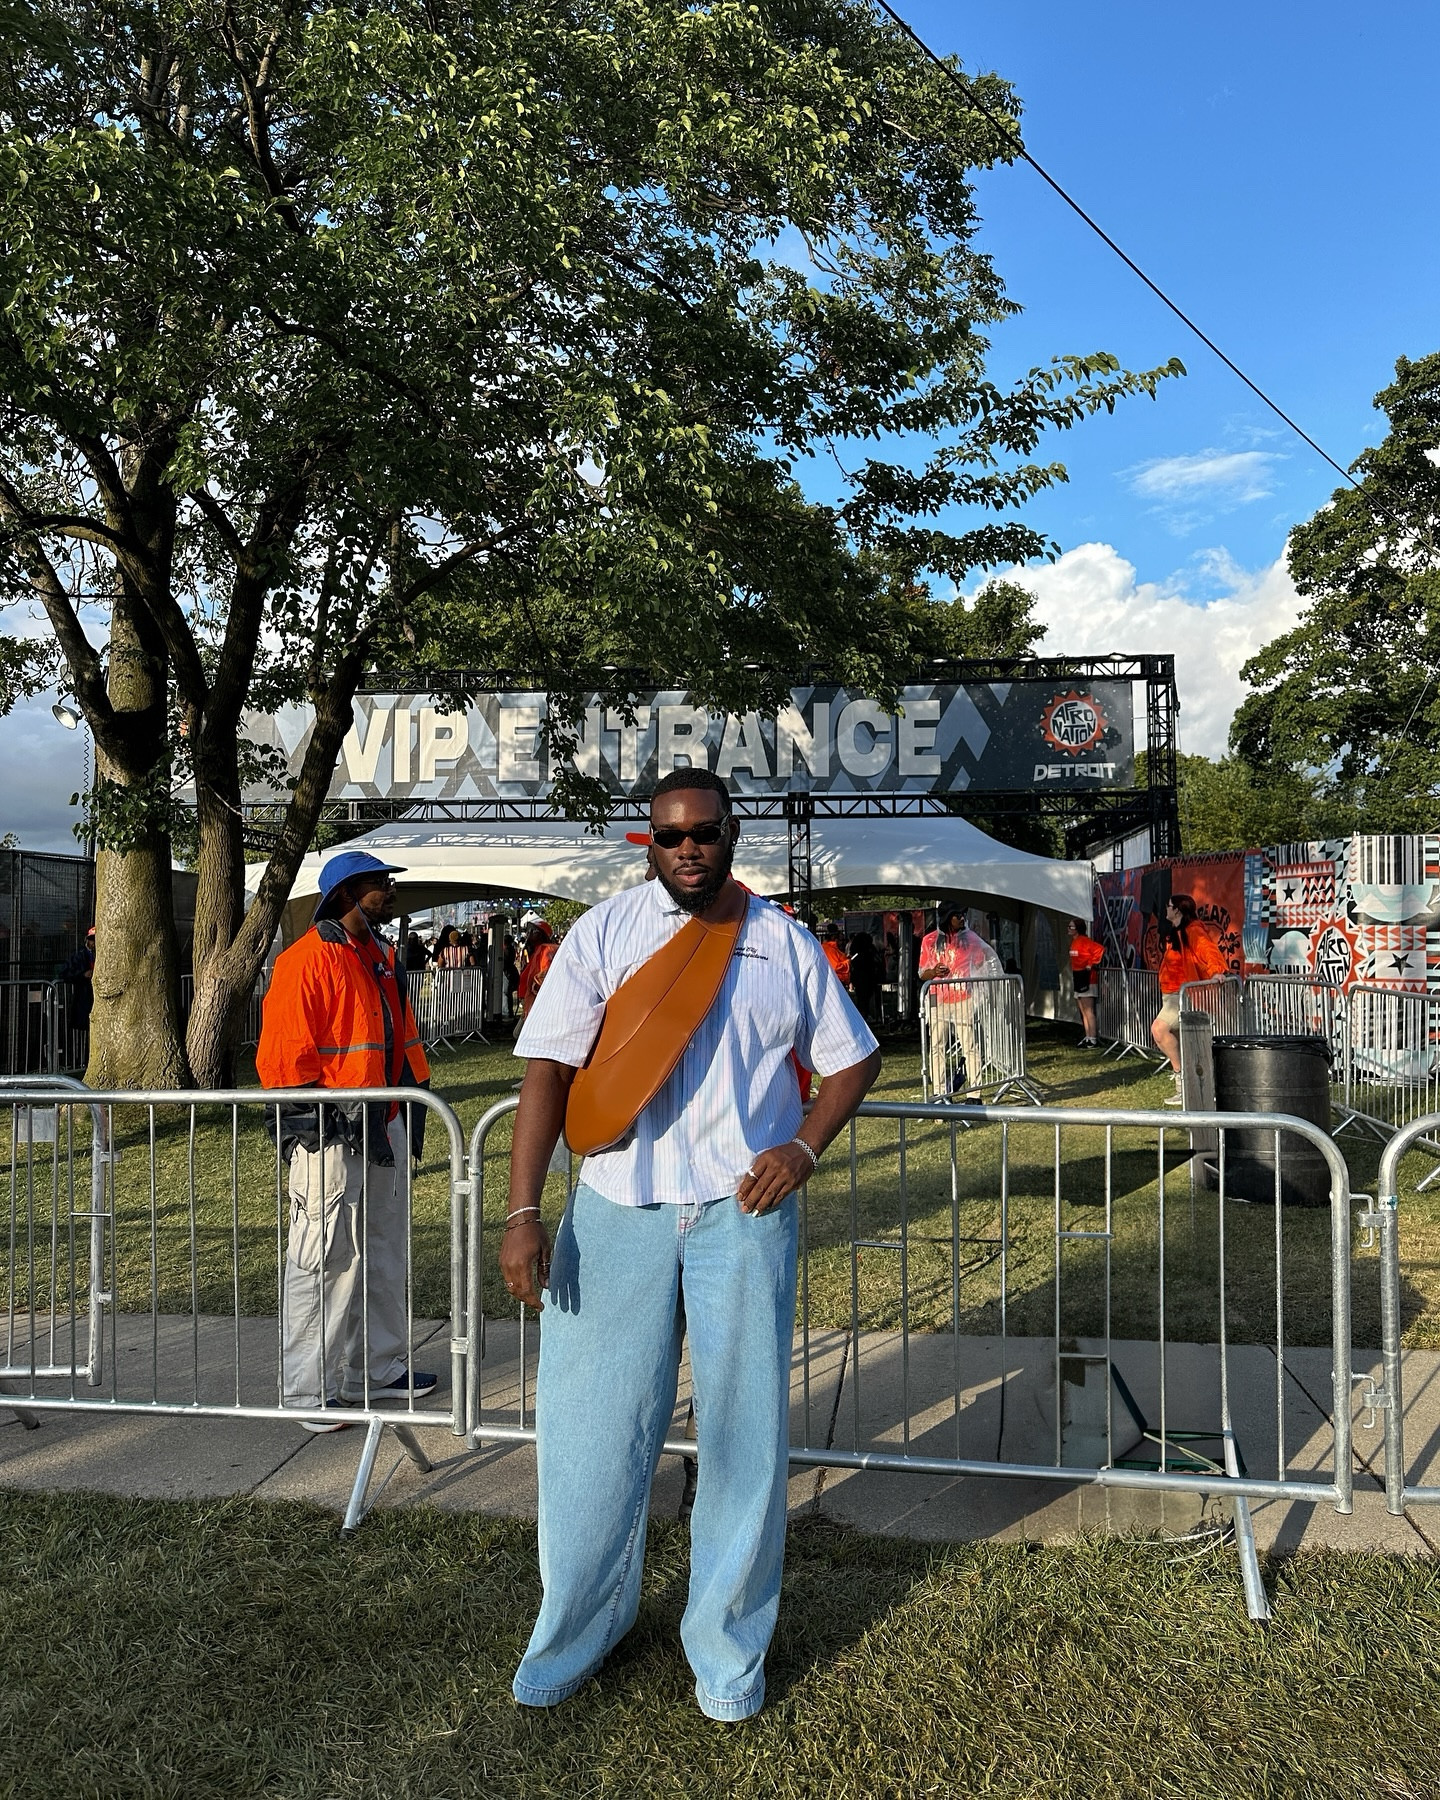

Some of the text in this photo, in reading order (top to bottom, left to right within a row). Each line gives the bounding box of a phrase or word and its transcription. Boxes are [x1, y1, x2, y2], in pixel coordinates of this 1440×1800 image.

[1053, 702, 1093, 724] AFRO
[342, 700, 941, 782] VIP ENTRANCE
[1051, 718, 1096, 745] NATION
[1033, 762, 1115, 781] DETROIT
[1318, 927, 1349, 959] AFRO
[1314, 951, 1351, 985] NATION
